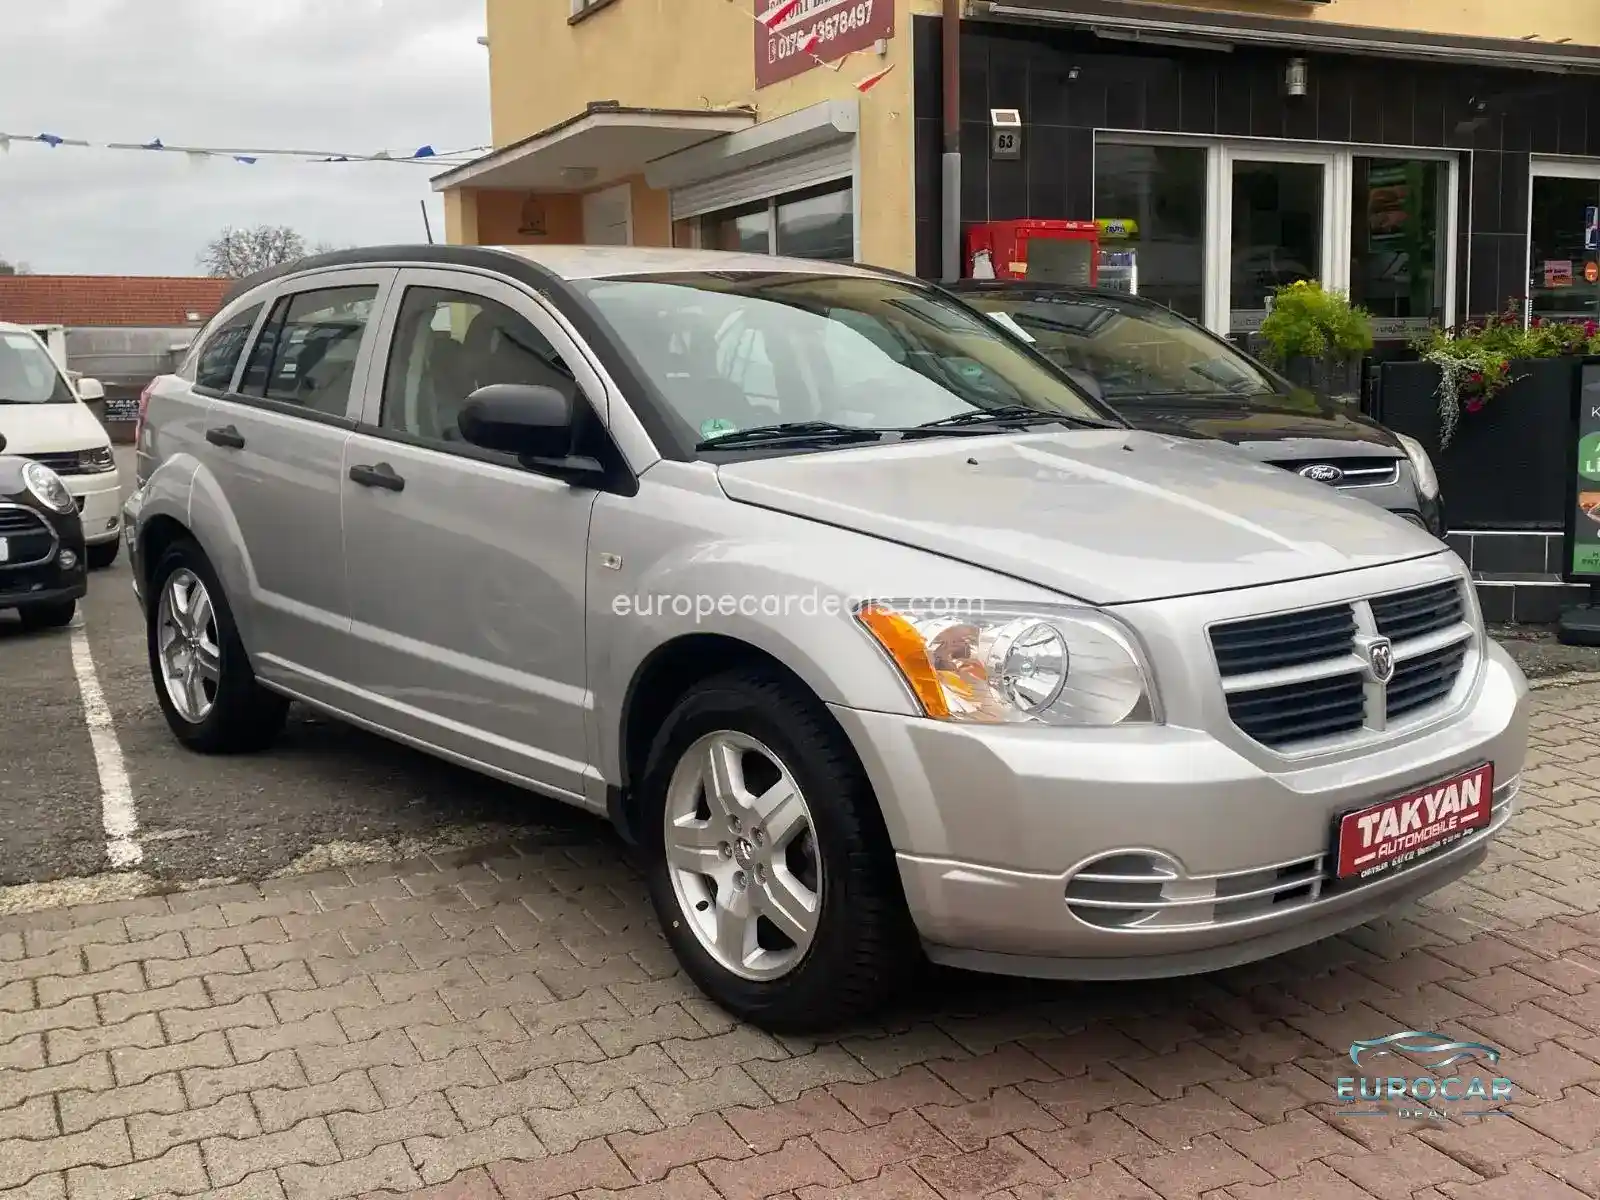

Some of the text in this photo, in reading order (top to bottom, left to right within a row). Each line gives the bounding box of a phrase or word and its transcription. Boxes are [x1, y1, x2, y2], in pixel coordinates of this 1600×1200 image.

[999, 134, 1013, 149] 63
[1311, 466, 1335, 479] Ford
[1357, 773, 1483, 849] TAKYAN
[1377, 815, 1458, 859] AUTOMOBILE
